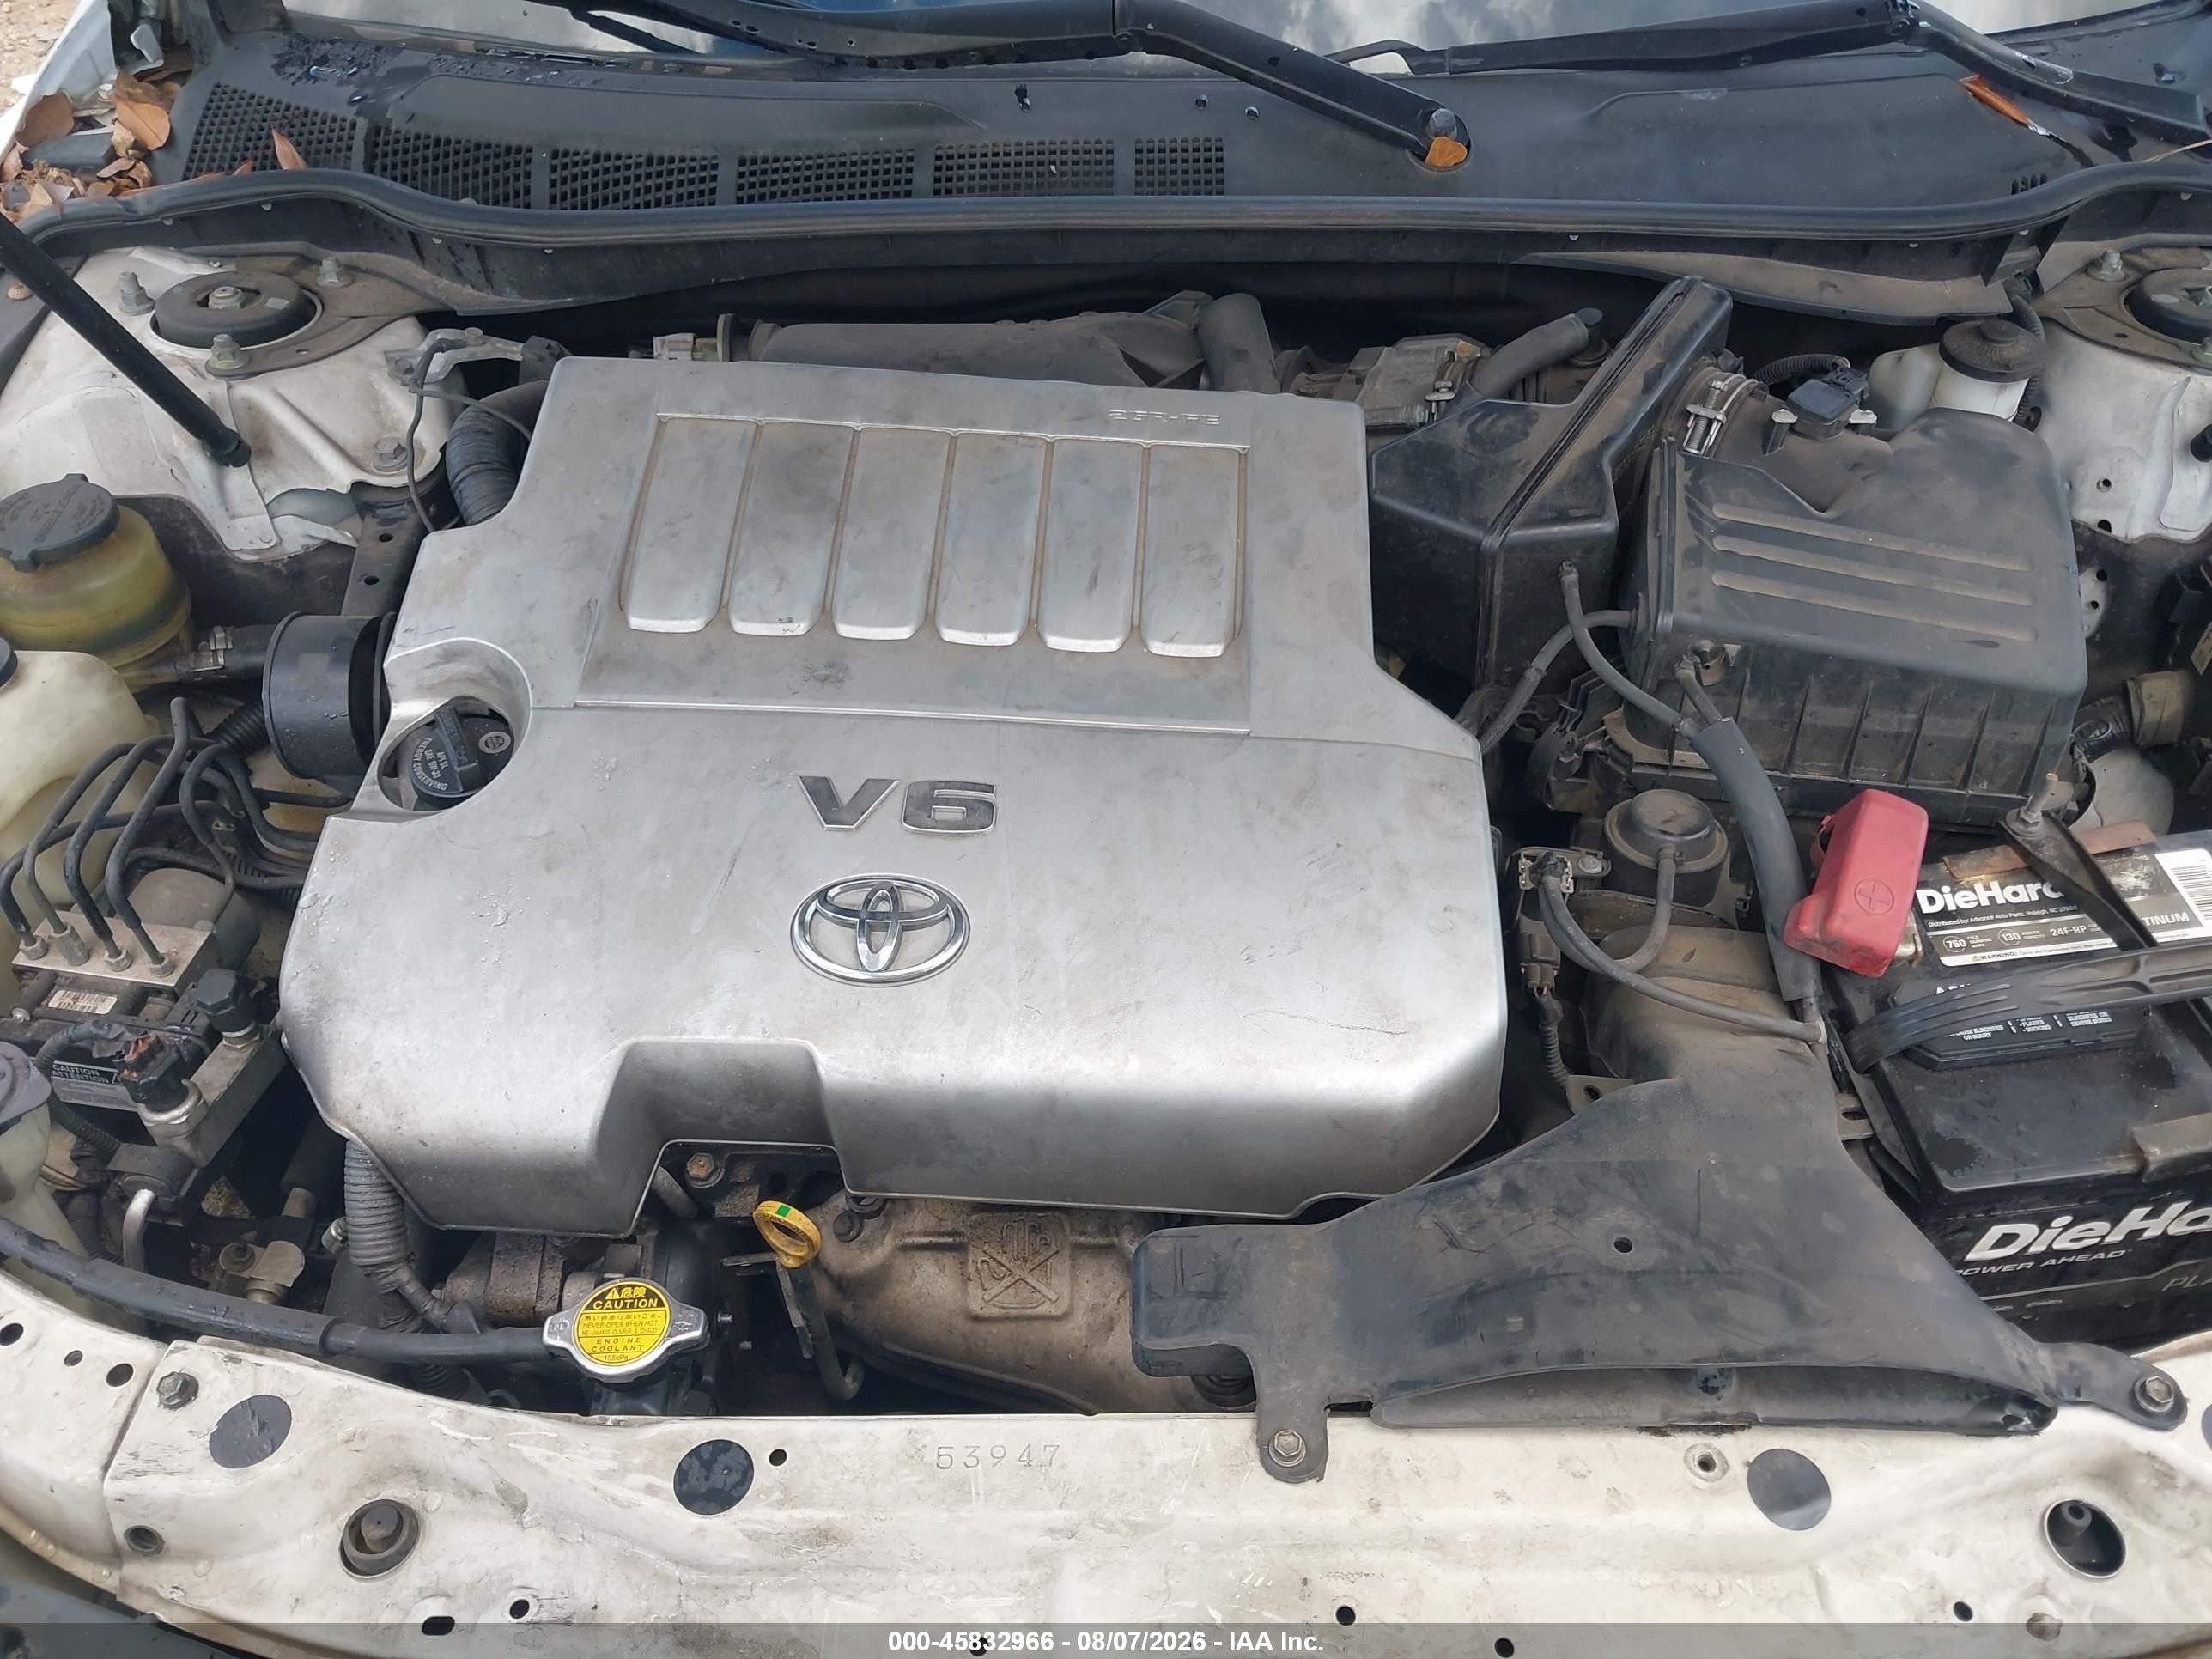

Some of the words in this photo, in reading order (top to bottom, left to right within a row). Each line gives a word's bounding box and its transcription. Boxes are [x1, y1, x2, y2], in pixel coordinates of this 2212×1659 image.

[797, 775, 997, 835] V6
[1928, 919, 1960, 927] Distributed
[2141, 912, 2190, 927] TINUM
[2049, 925, 2087, 937] 24F-RP
[2002, 933, 2021, 942] 130
[1945, 939, 1967, 949] 750
[52, 1065, 100, 1076] CAUTION
[52, 1070, 109, 1083] ATTENTION
[2039, 1249, 2126, 1267] AHEAD
[592, 1298, 658, 1310] CAUTION
[591, 1344, 645, 1352] COOLANT
[935, 1443, 1060, 1470] 53947
